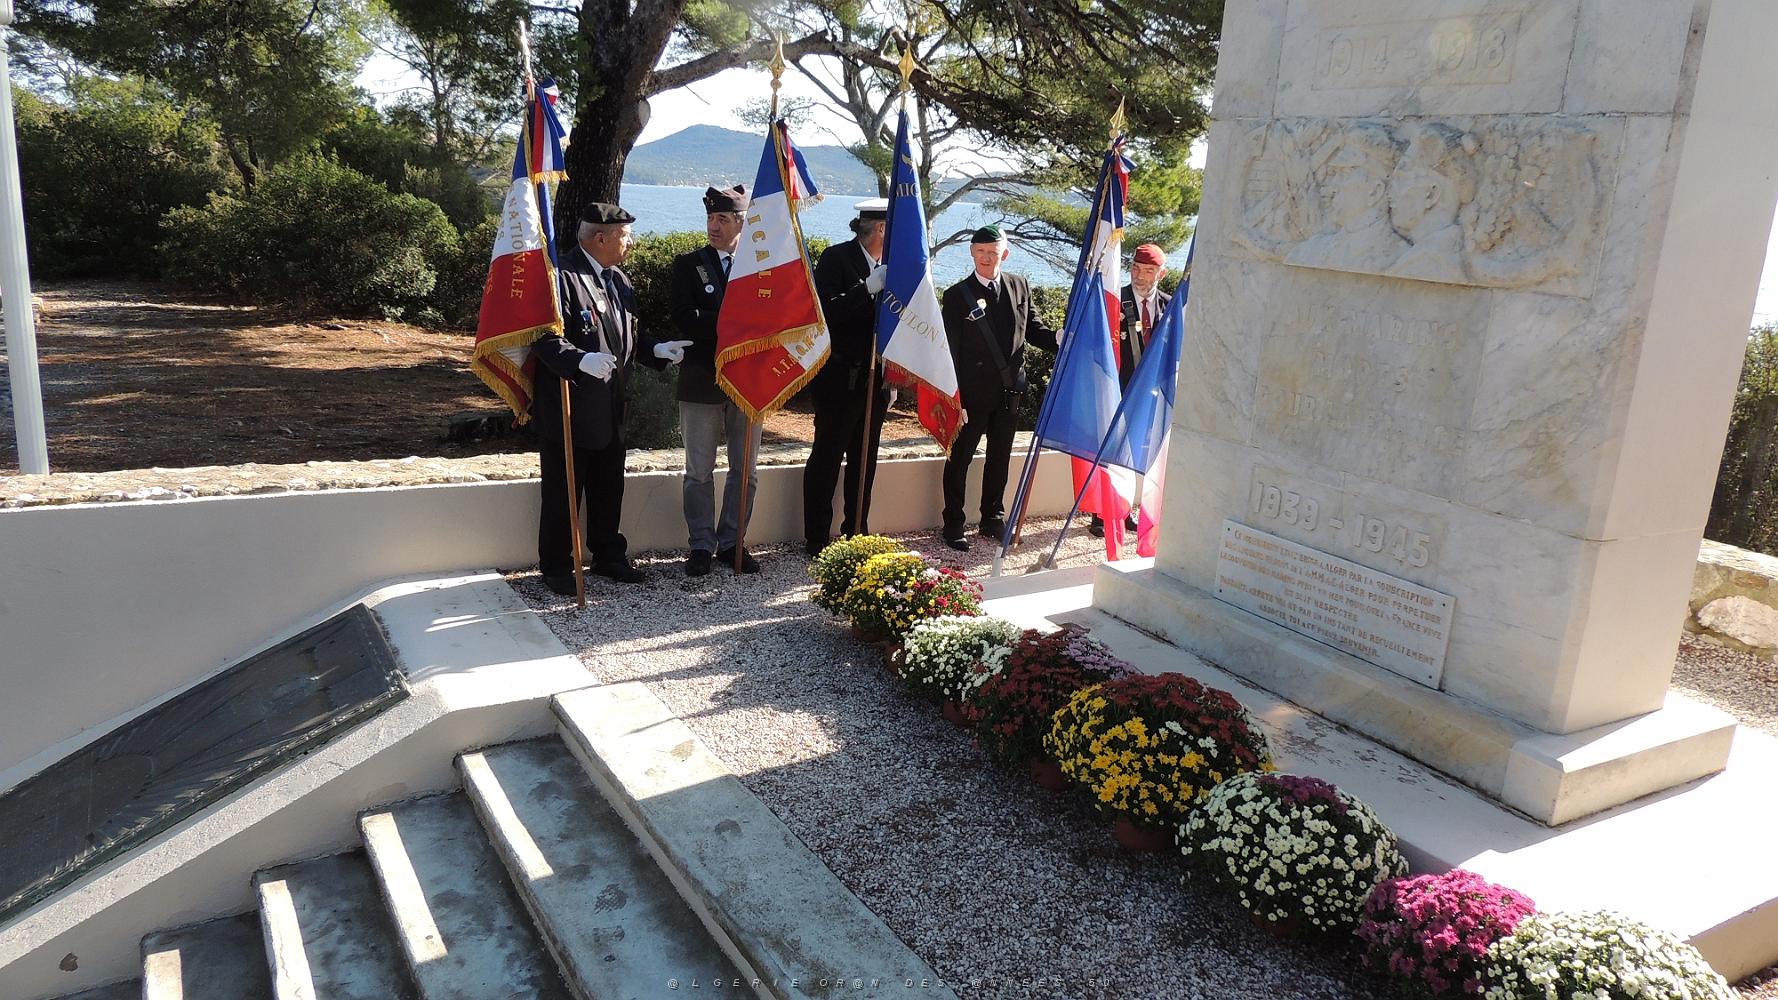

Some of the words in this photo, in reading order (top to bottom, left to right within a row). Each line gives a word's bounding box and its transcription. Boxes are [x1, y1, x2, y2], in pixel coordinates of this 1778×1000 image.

[1325, 32, 1390, 77] 1914
[1429, 26, 1507, 71] 1918
[509, 196, 526, 299] NATIONALE
[883, 290, 940, 343] TOULON
[1253, 480, 1320, 532] 1939
[1352, 513, 1431, 568] 1945
